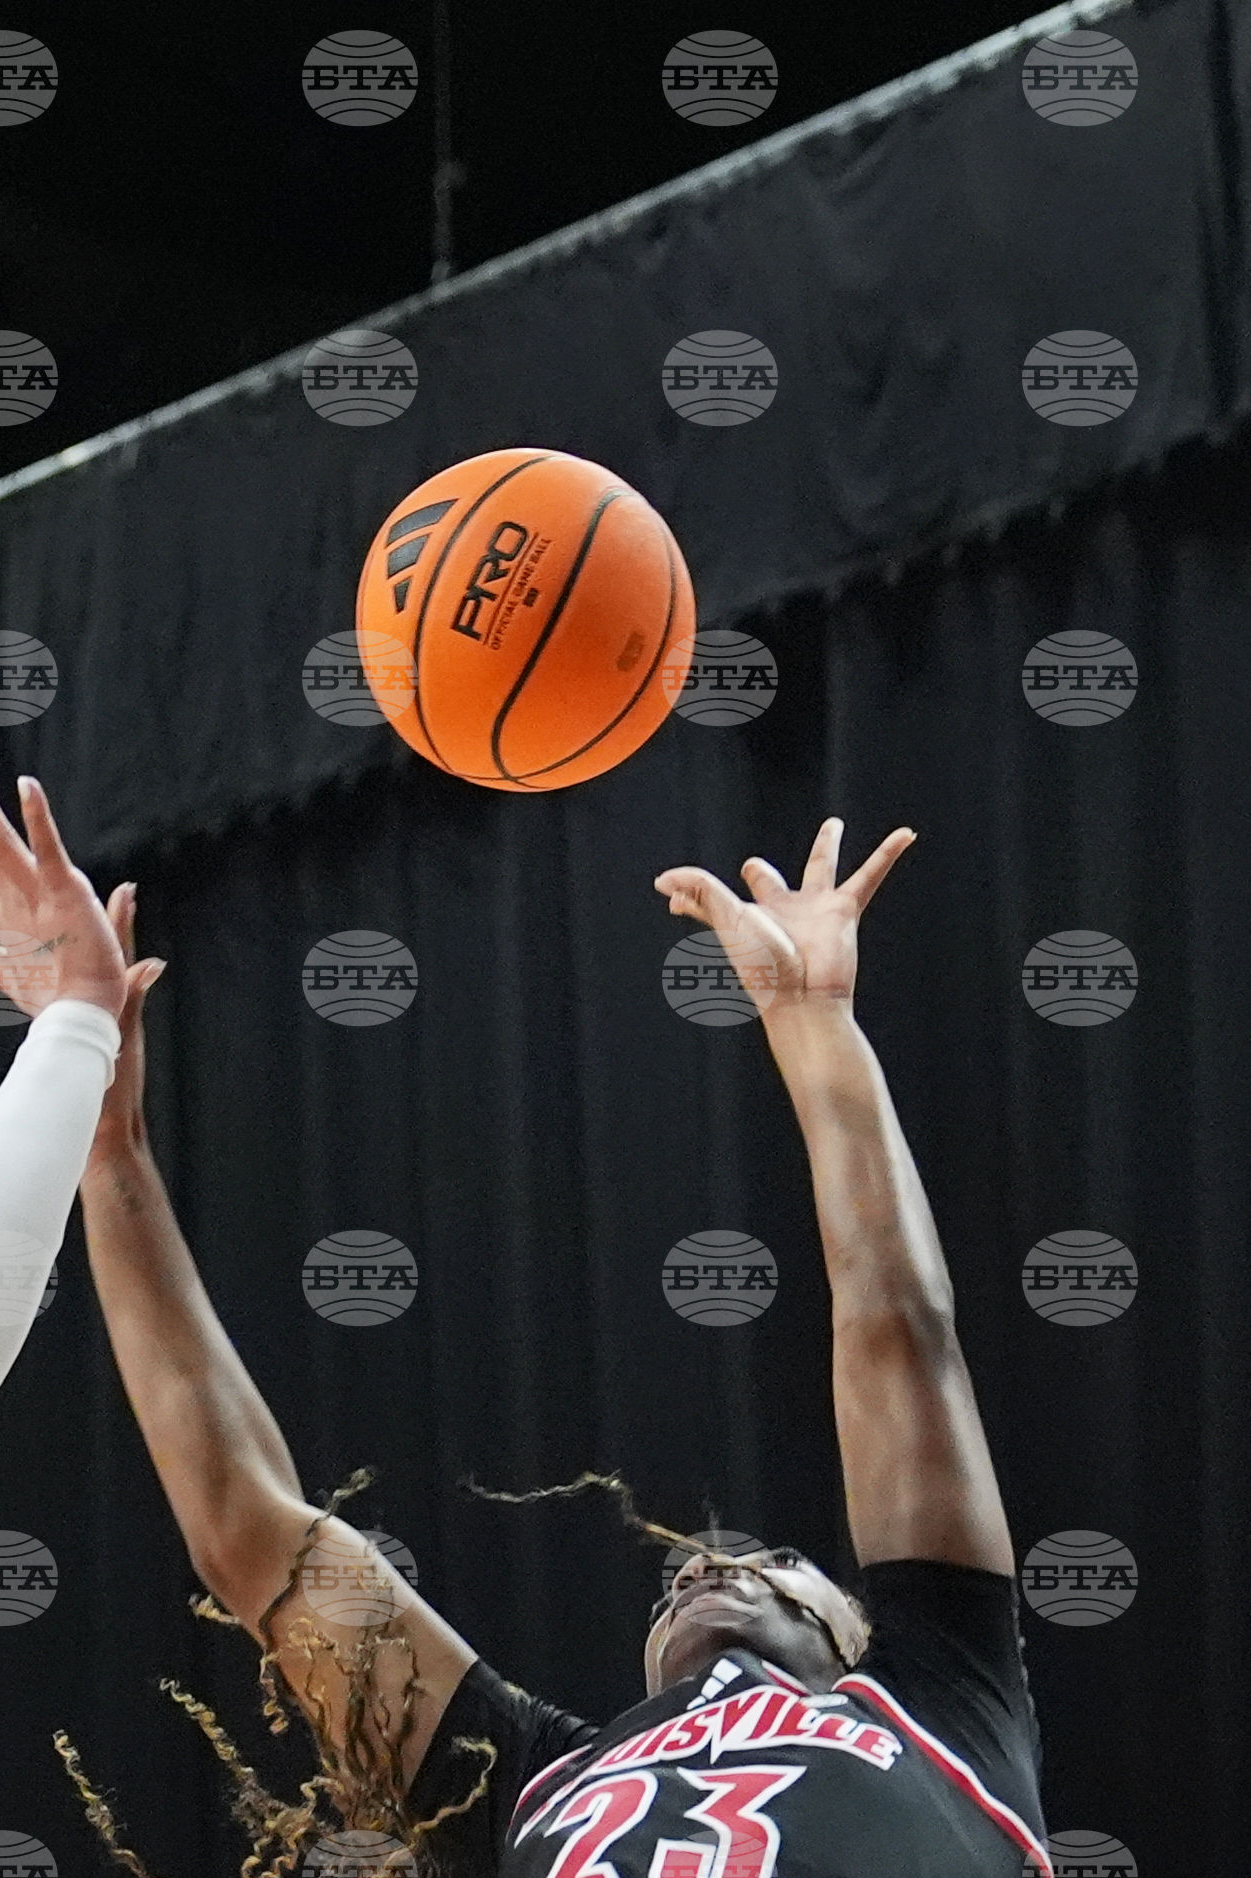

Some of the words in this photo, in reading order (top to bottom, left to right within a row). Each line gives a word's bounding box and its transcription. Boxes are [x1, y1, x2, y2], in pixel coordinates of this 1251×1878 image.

[450, 521, 528, 642] PRO
[490, 600, 518, 650] OFFICIAL
[512, 563, 535, 597] GAME
[529, 538, 553, 564] BALL
